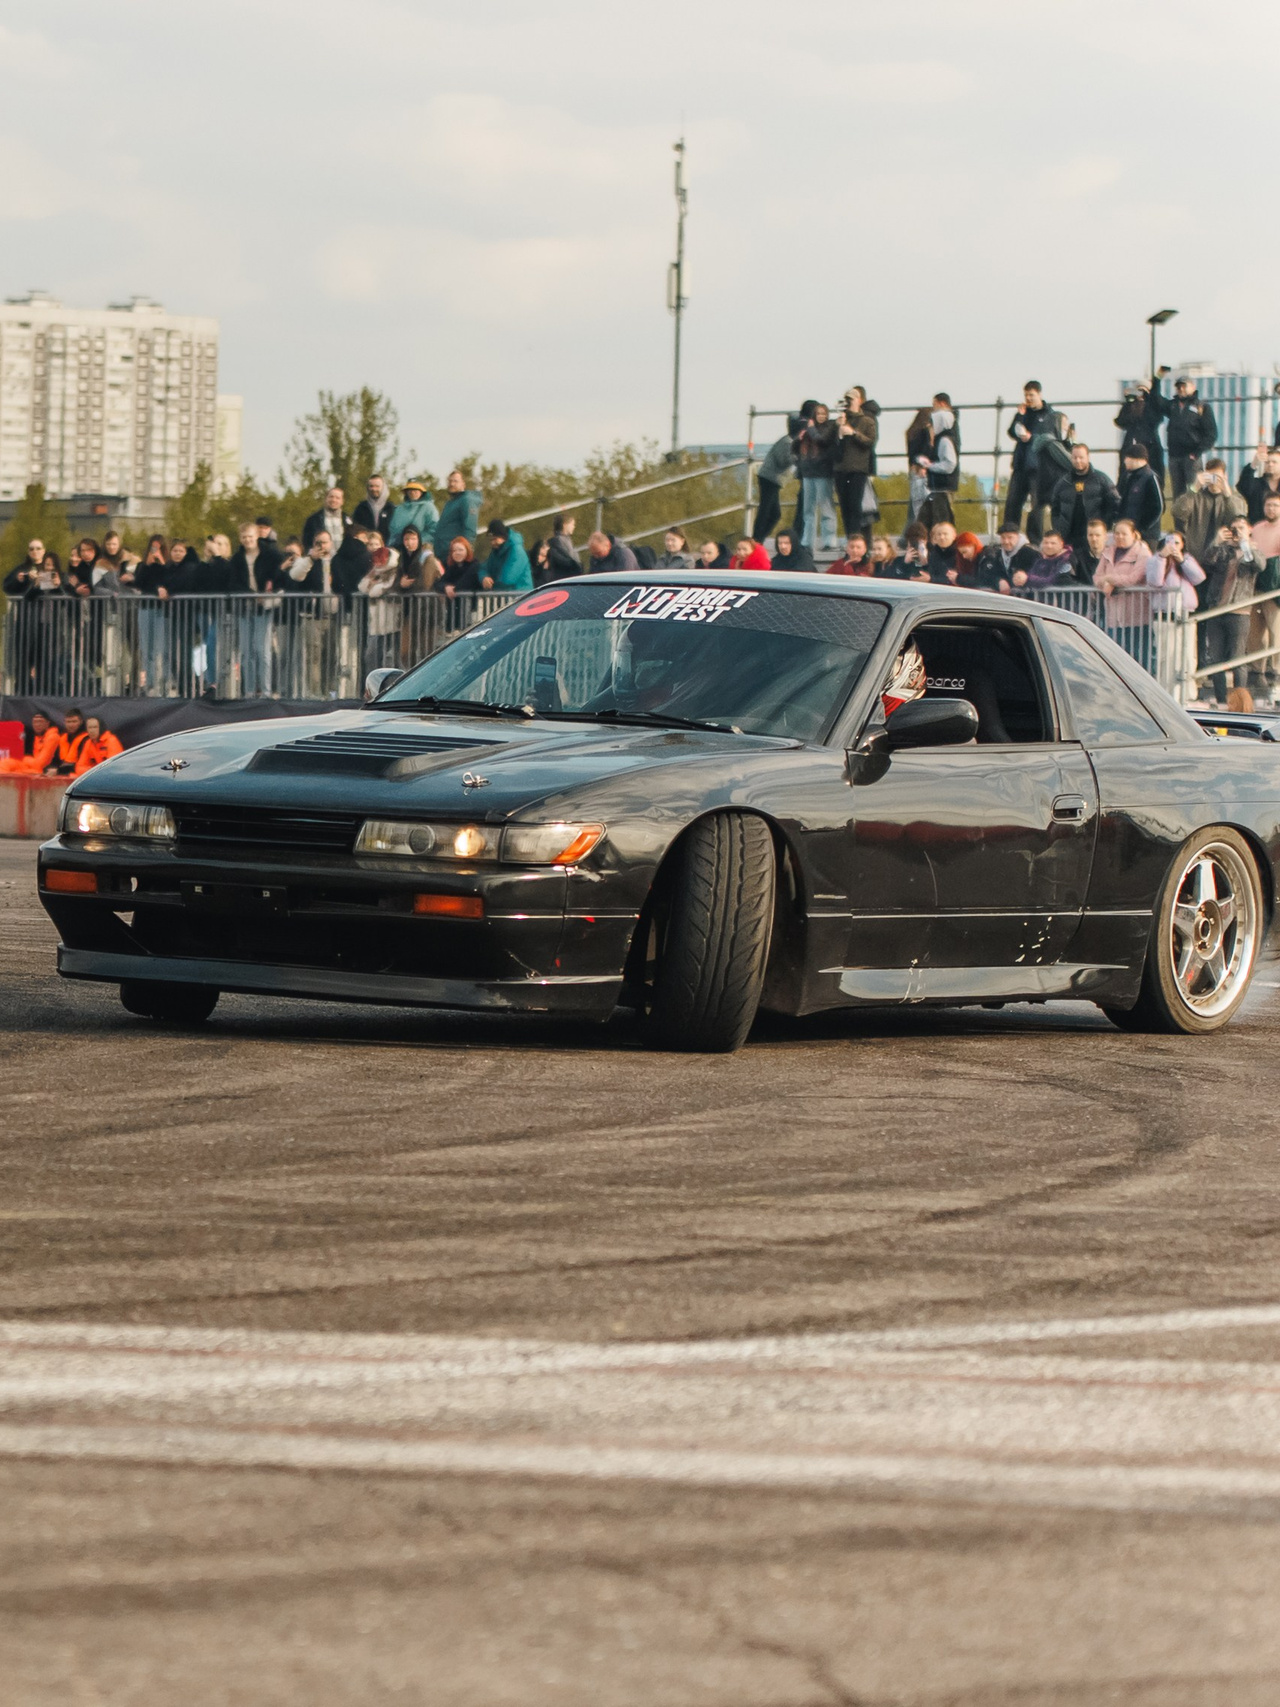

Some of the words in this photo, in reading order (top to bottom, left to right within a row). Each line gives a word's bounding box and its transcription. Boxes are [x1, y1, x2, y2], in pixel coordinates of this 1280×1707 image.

[676, 588, 760, 609] DRIFT
[660, 603, 732, 623] FEST
[926, 677, 966, 688] parco
